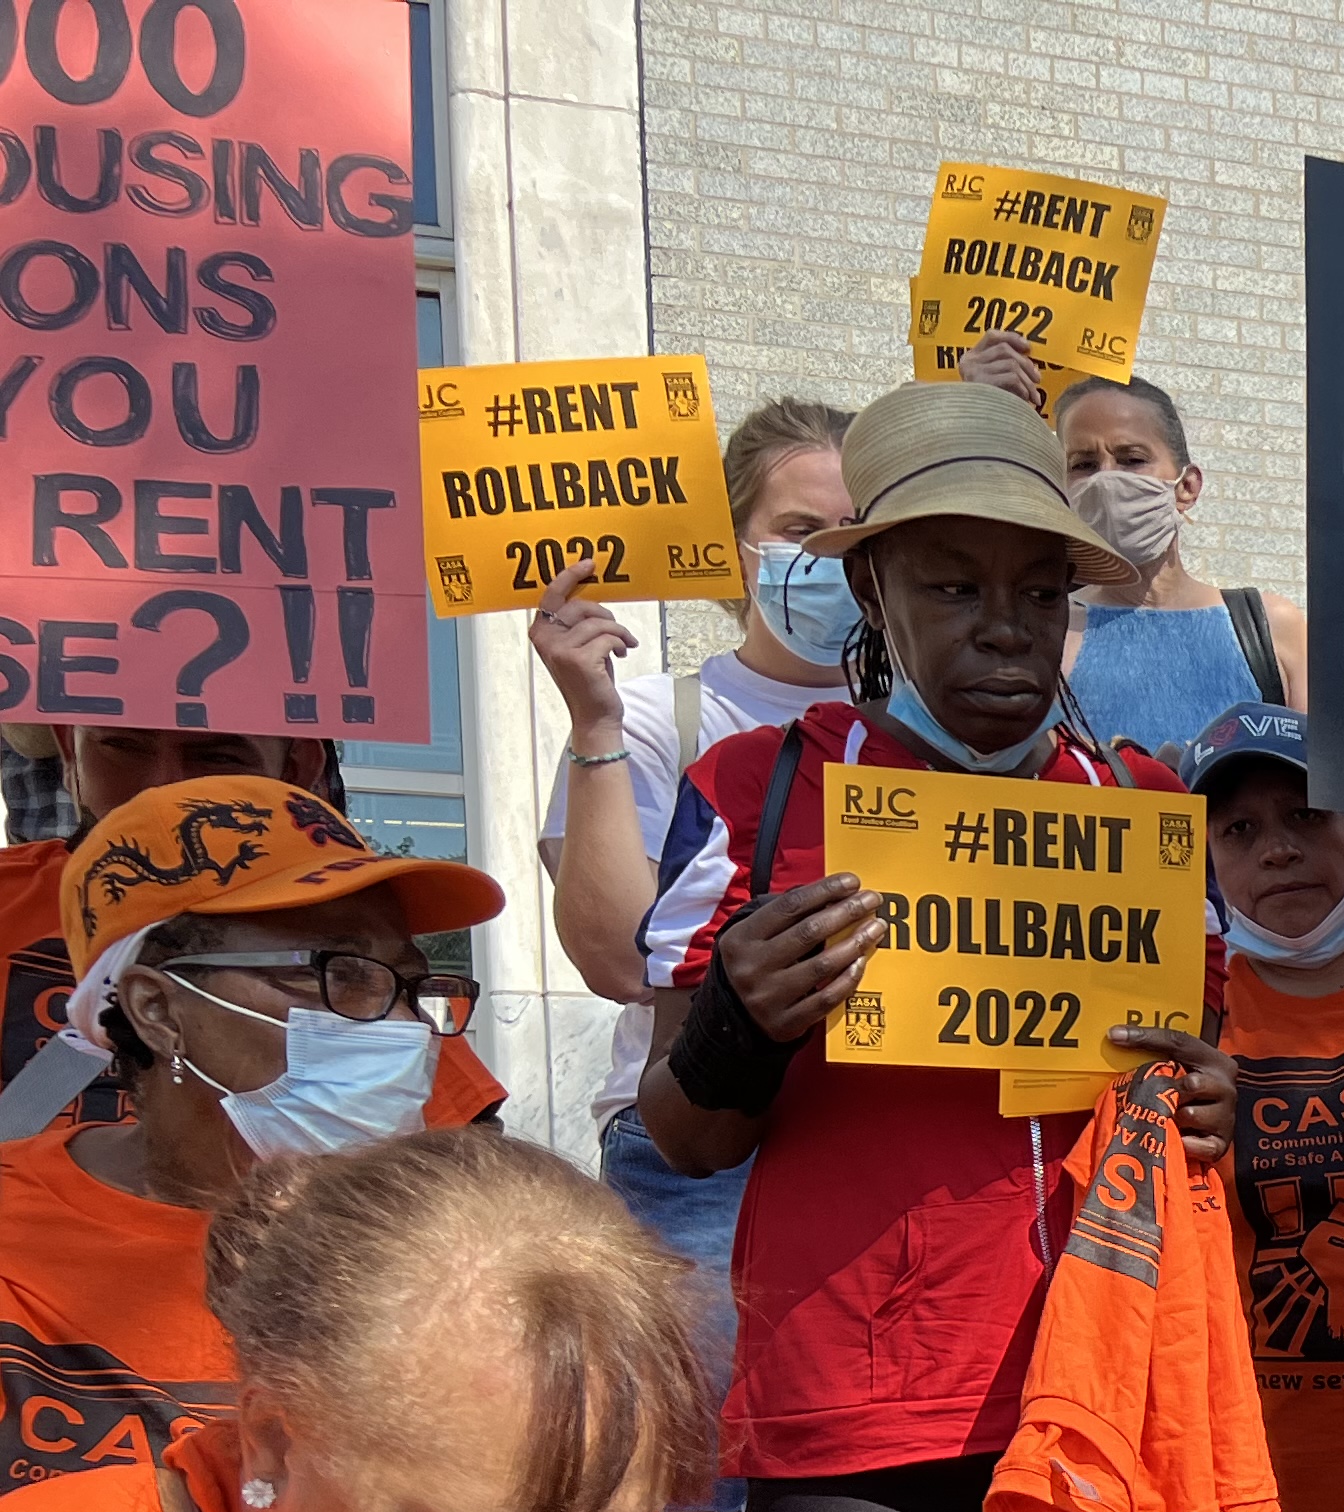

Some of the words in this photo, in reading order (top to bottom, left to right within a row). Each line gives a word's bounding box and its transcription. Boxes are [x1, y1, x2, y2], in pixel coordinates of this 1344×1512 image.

[0, 0, 246, 118] 00
[945, 174, 985, 193] RJC
[993, 189, 1112, 239] #RENT
[943, 238, 1120, 302] ROLLBACK
[1081, 327, 1128, 356] RJC
[418, 382, 461, 409] JC
[484, 381, 640, 438] #RENT
[441, 456, 689, 520] ROLLBACK
[32, 472, 396, 581] RENT
[506, 534, 631, 591] 2022
[667, 543, 728, 569] RJC
[844, 783, 917, 817] RJC
[944, 808, 1131, 874] #RENT
[874, 892, 1161, 964] ROLLBACK
[937, 986, 1081, 1048] 2022
[1252, 1155, 1279, 1171] for
[1284, 1151, 1325, 1167] Safe
